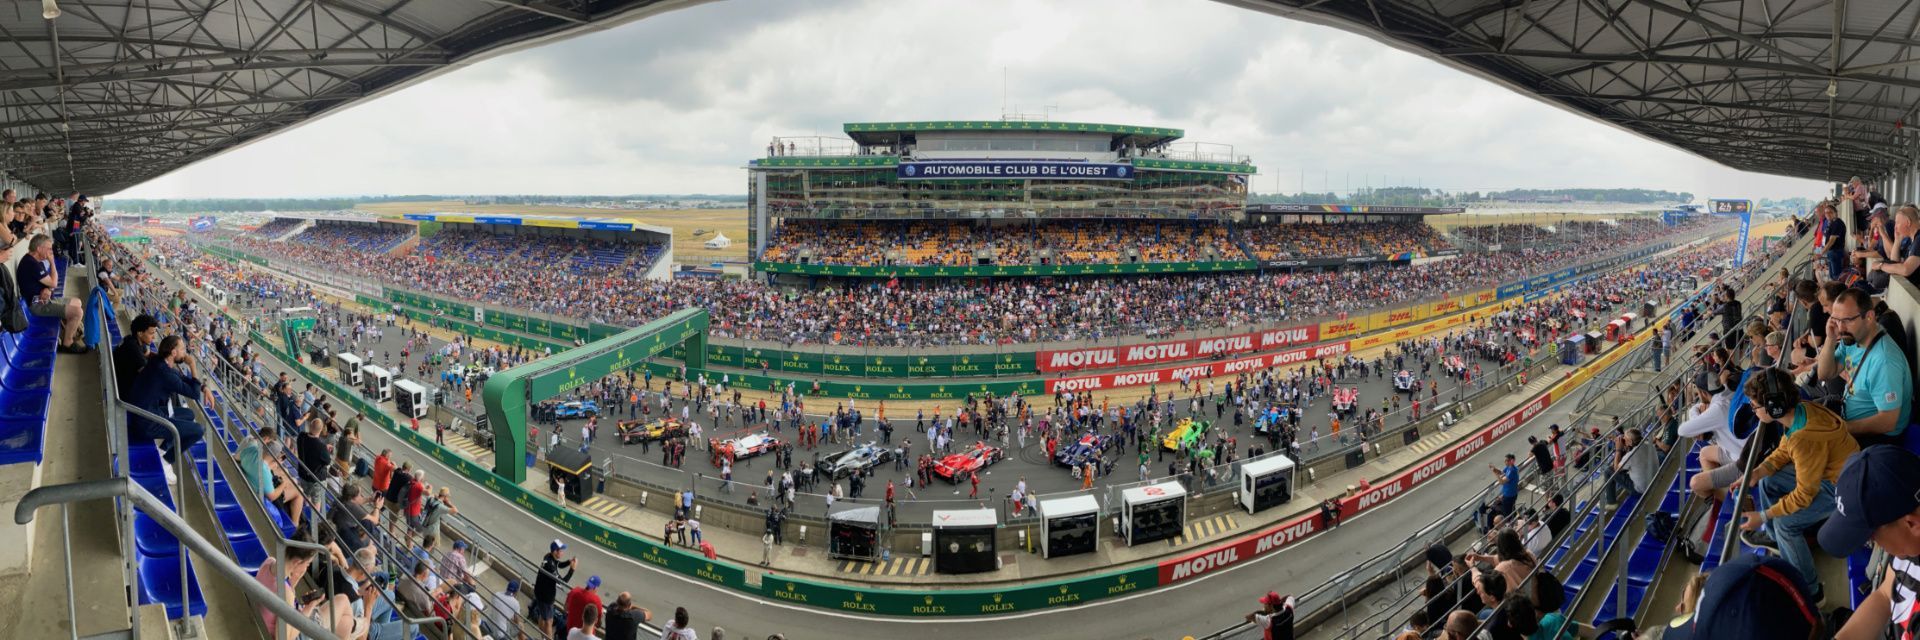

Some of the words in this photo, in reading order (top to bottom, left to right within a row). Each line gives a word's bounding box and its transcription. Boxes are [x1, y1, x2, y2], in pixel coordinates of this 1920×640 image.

[924, 166, 1001, 175] AUTOMOBILE
[1005, 166, 1038, 175] CLUB
[1041, 166, 1057, 175] DE
[1328, 323, 1357, 335] DHL
[1198, 336, 1253, 353] MOTUL
[1262, 329, 1309, 346] MOTUL
[650, 342, 666, 354] ROLEX
[1127, 343, 1189, 361] MOTUL
[1315, 344, 1346, 357] MOTUL
[610, 358, 631, 373] ROLEX
[784, 361, 808, 369] ROLEX
[1051, 349, 1117, 367] MOTUL
[1224, 358, 1264, 373] MOTUL
[1273, 351, 1308, 365] MOTUL
[824, 364, 850, 372] ROLEX
[559, 376, 585, 393] ROLEX
[1114, 372, 1160, 387] MOTUL
[1522, 401, 1543, 419] MOTUL
[1492, 418, 1516, 439] MOTUL
[1455, 436, 1485, 461] MOTUL
[1412, 456, 1447, 485] MOTUL
[485, 479, 501, 492] ROLEX
[516, 497, 534, 510] ROLEX
[1358, 482, 1402, 510] MOTUL
[554, 515, 573, 530] ROLEX
[595, 535, 617, 549] ROLEX
[1256, 520, 1314, 554] MOTUL
[643, 552, 668, 566] ROLEX
[1172, 547, 1239, 581] MOTUL
[697, 568, 724, 583] ROLEX
[775, 590, 807, 601] ROLEX
[1108, 582, 1136, 594] ROLEX
[843, 601, 876, 611] ROLEX
[1048, 593, 1080, 604] ROLEX
[981, 603, 1014, 612] ROLEX
